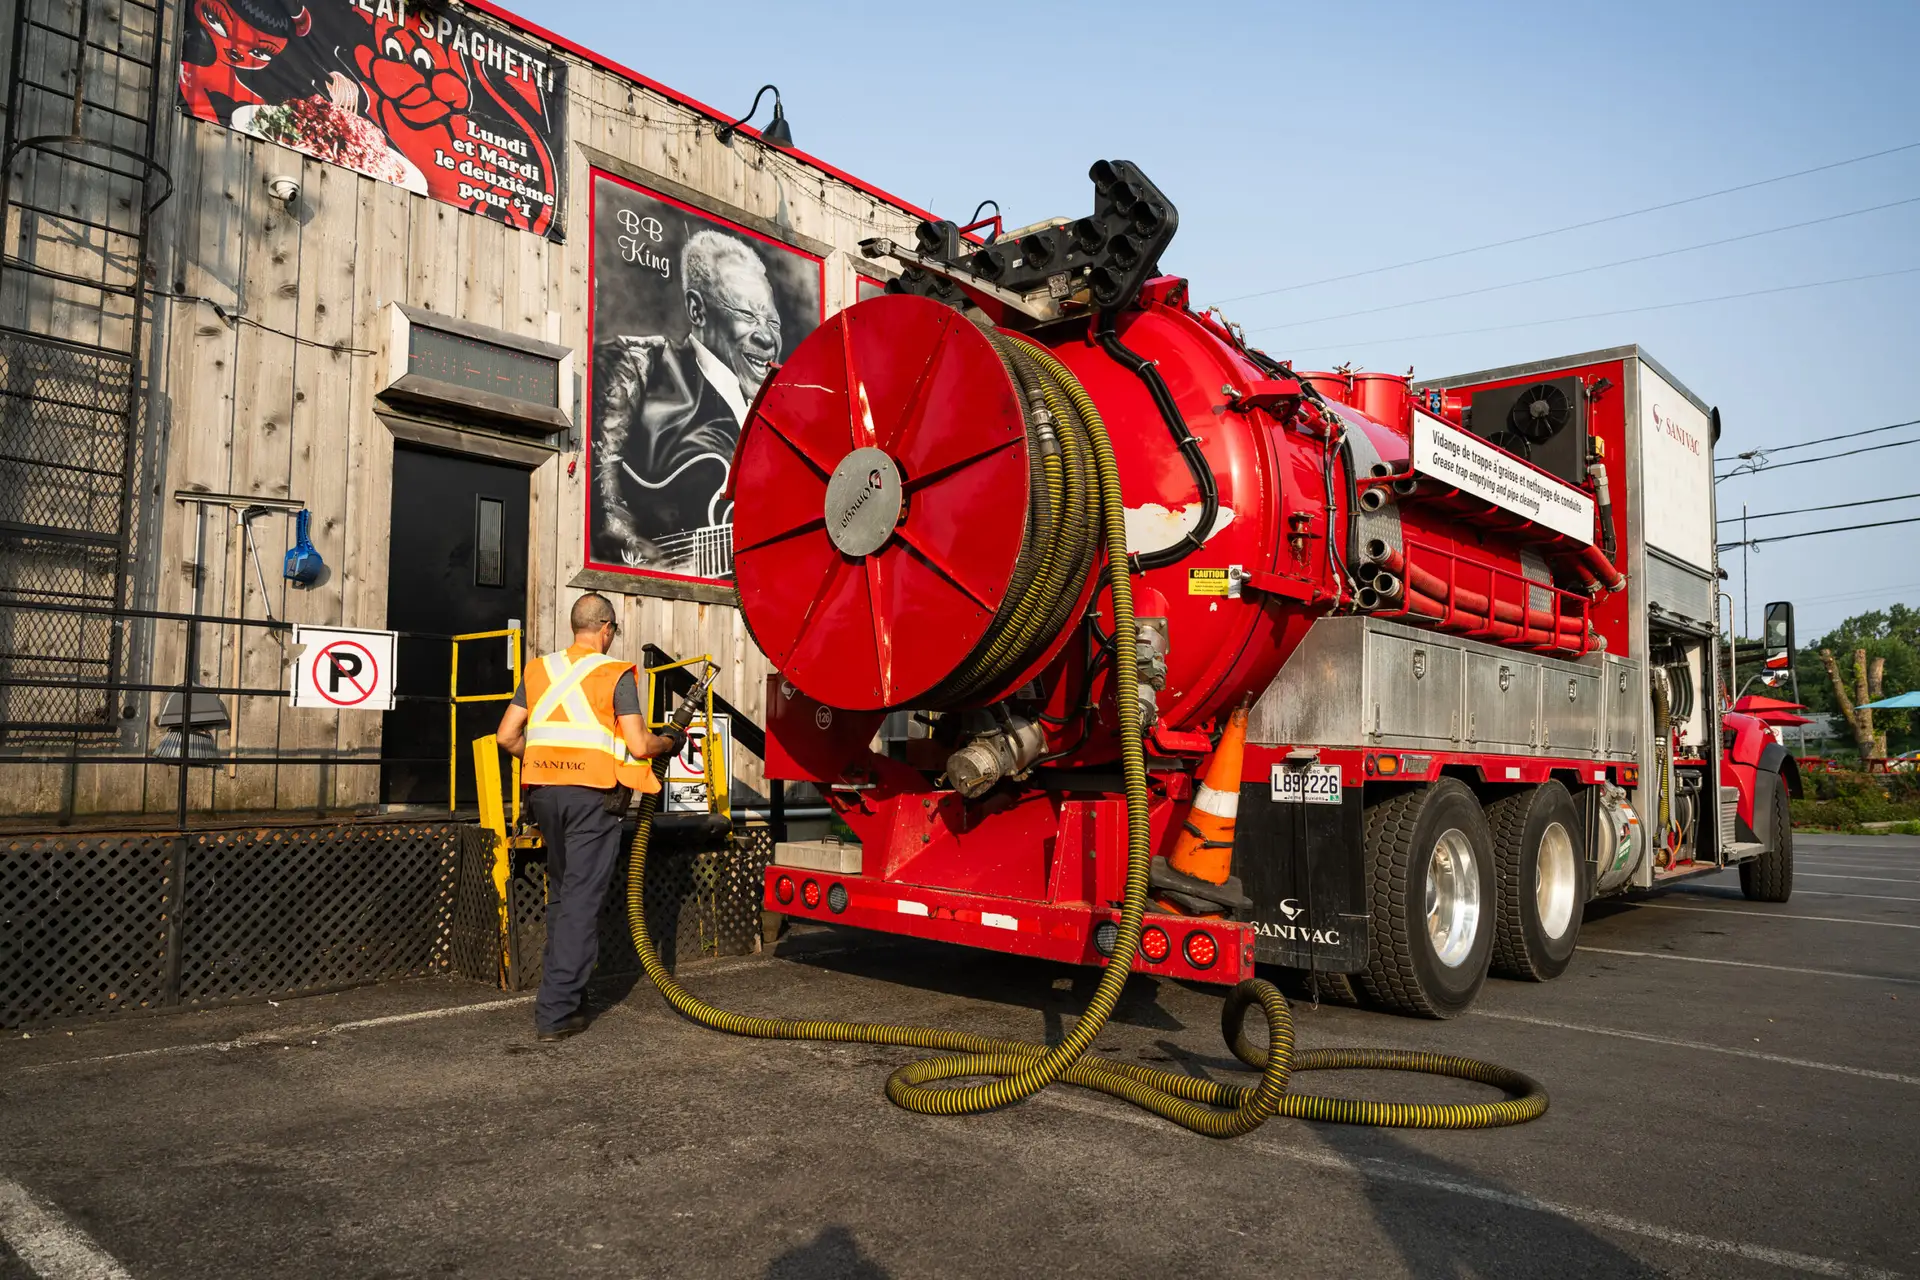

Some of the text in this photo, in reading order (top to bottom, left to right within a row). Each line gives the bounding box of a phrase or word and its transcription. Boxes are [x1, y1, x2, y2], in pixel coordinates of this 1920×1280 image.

[419, 10, 555, 93] SPAGHETTI
[466, 120, 528, 157] Lundi
[435, 150, 555, 205] le deuxième
[452, 140, 540, 181] et Mardi
[458, 183, 532, 217] pour $1
[617, 209, 663, 242] BB
[618, 235, 670, 278] King
[1432, 429, 1461, 458] Vidange
[1461, 444, 1471, 460] de
[1471, 450, 1492, 472] trappe
[1498, 465, 1519, 484] graisse
[1519, 475, 1526, 488] et
[1526, 478, 1553, 502] nettoyage
[1553, 489, 1561, 504] de
[1561, 496, 1582, 514] conduite
[1432, 452, 1540, 516] Grease trap emptying and pipe cleaning
[1193, 570, 1225, 579] CAUTION
[532, 760, 586, 771] SANIVAC
[1274, 773, 1338, 794] L892226
